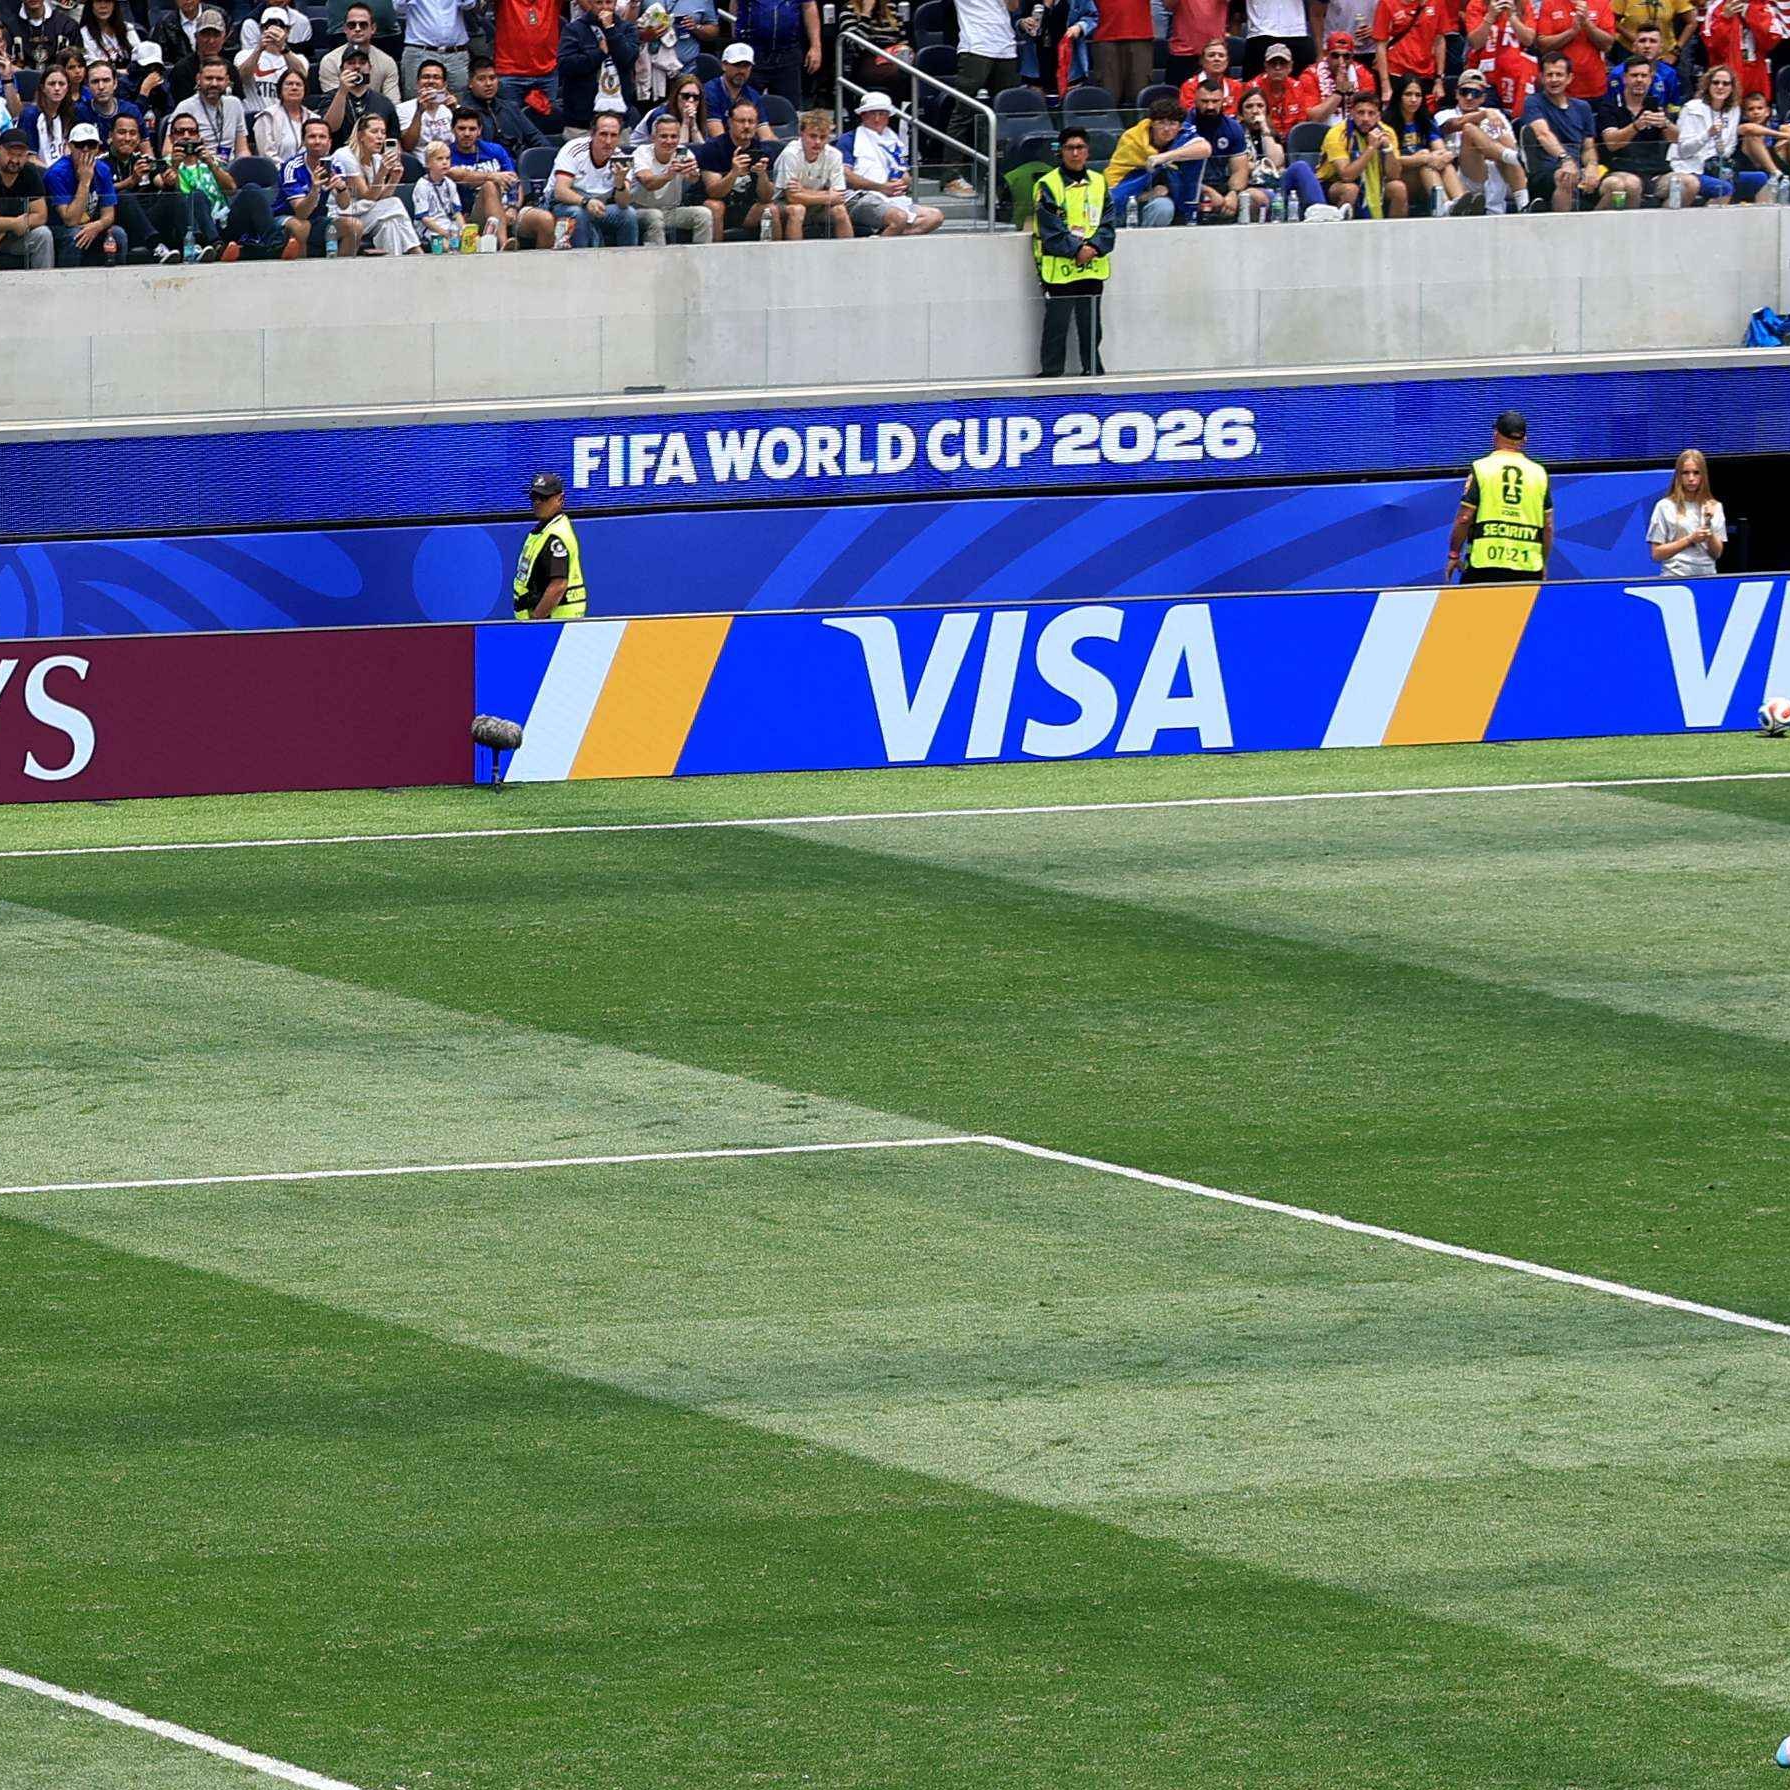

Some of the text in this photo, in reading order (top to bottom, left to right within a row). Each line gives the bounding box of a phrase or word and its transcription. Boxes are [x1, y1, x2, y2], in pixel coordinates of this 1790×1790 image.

[572, 407, 1257, 488] FIFA WORLD CUP 2026
[1487, 546, 1529, 562] 0721
[822, 604, 1232, 762] VISA
